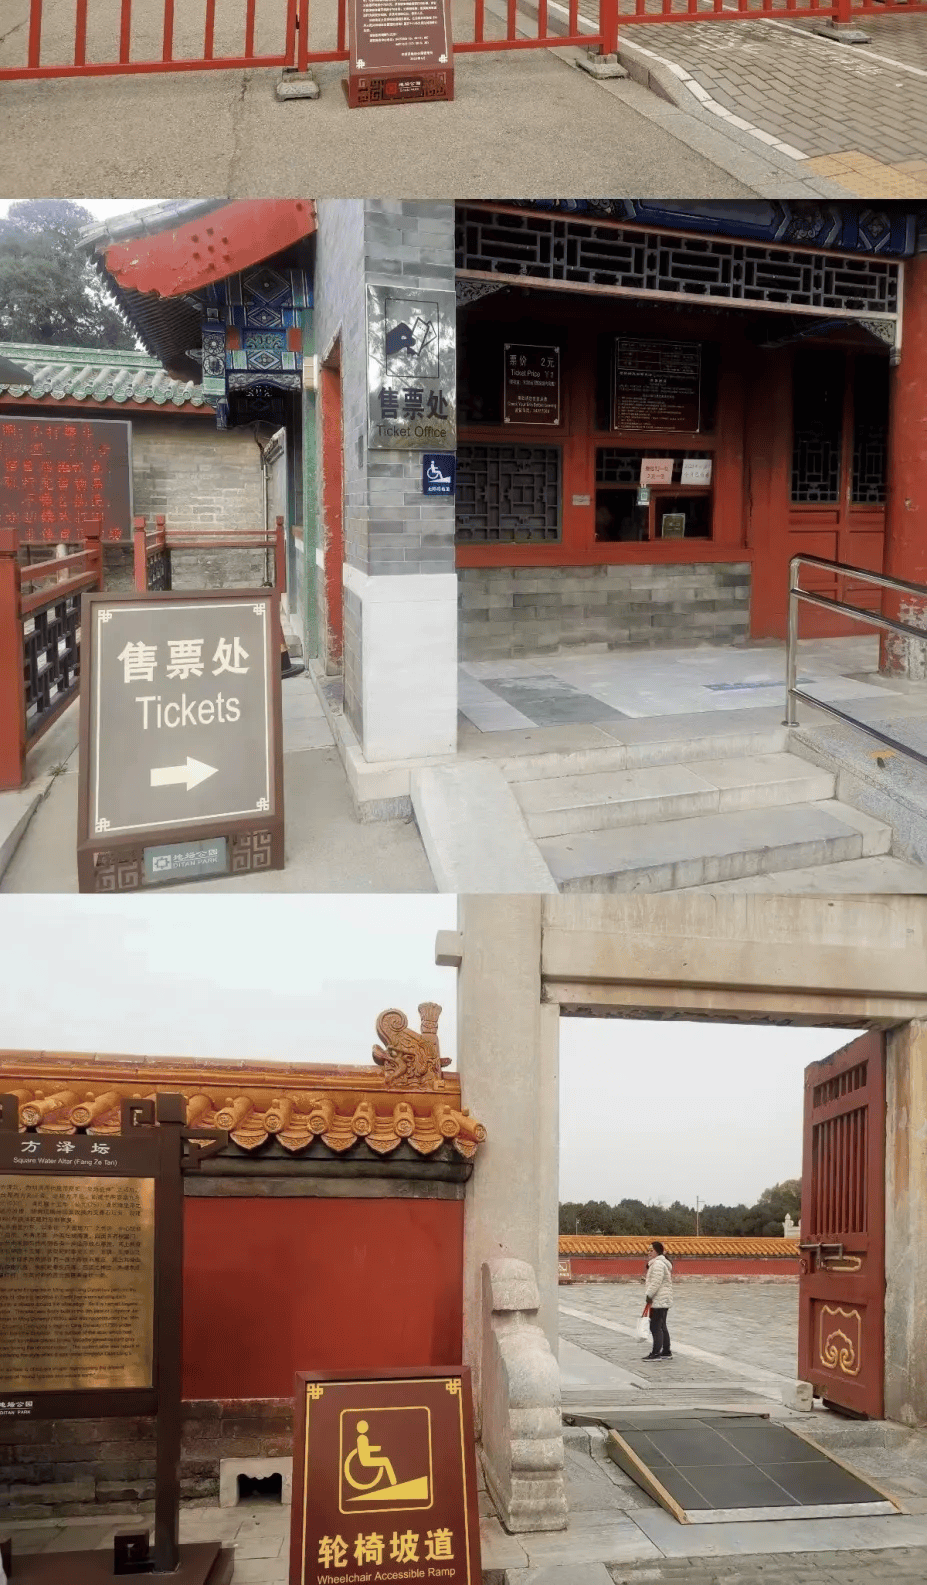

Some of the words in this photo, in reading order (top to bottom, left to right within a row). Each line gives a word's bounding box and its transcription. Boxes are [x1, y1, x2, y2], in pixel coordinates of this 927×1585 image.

[378, 386, 449, 420] 售票处
[376, 425, 411, 437] Ticket
[414, 425, 447, 438] Office
[117, 637, 250, 683] 售票处
[135, 692, 241, 730] Tickets
[20, 1140, 111, 1155] 方泽坛
[13, 1157, 36, 1165] Square
[318, 1528, 455, 1568] 轮椅坡道
[317, 1572, 372, 1585] Wheelchair
[374, 1569, 425, 1581] Accessible
[428, 1567, 456, 1579] Ramp
